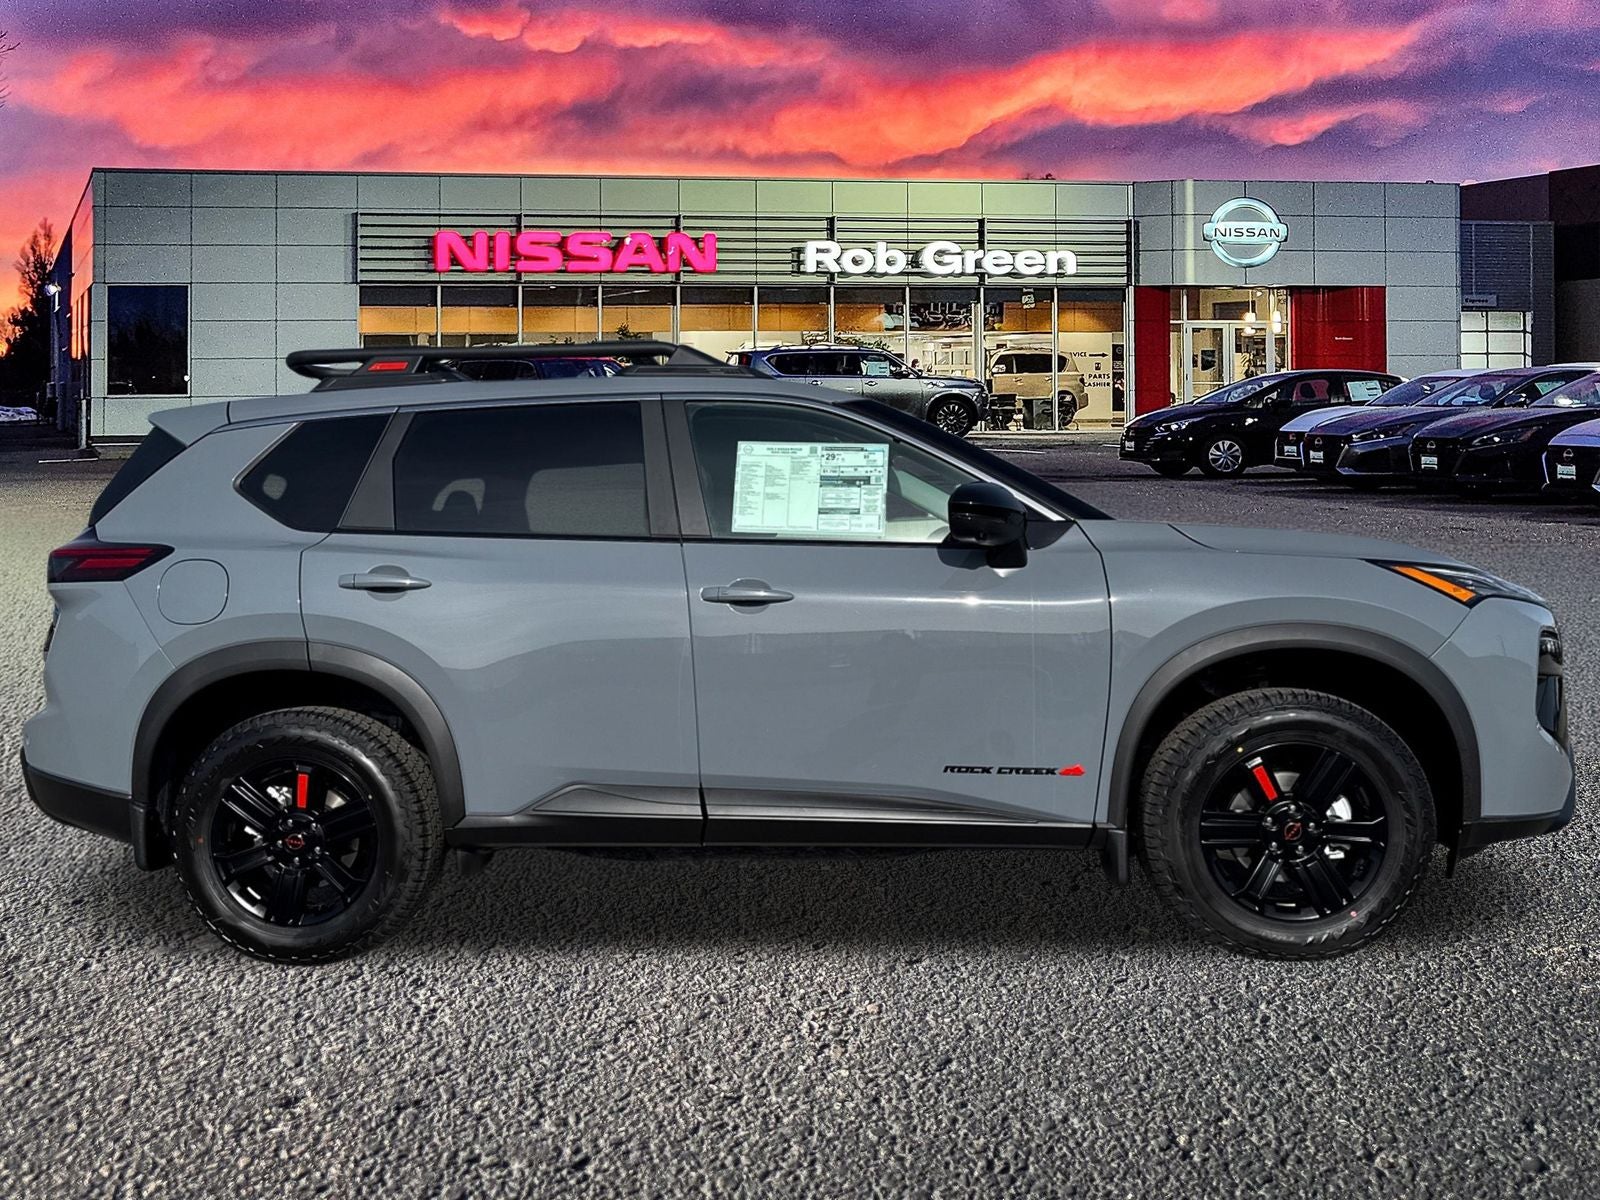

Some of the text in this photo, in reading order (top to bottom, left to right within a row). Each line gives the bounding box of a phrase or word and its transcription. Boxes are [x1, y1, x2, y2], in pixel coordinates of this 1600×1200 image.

[1214, 228, 1281, 238] NISSAN
[434, 230, 718, 273] NISSAN
[804, 239, 1078, 276] Rob Green
[825, 453, 836, 461] 29
[943, 765, 1059, 776] ROCK CREEK
